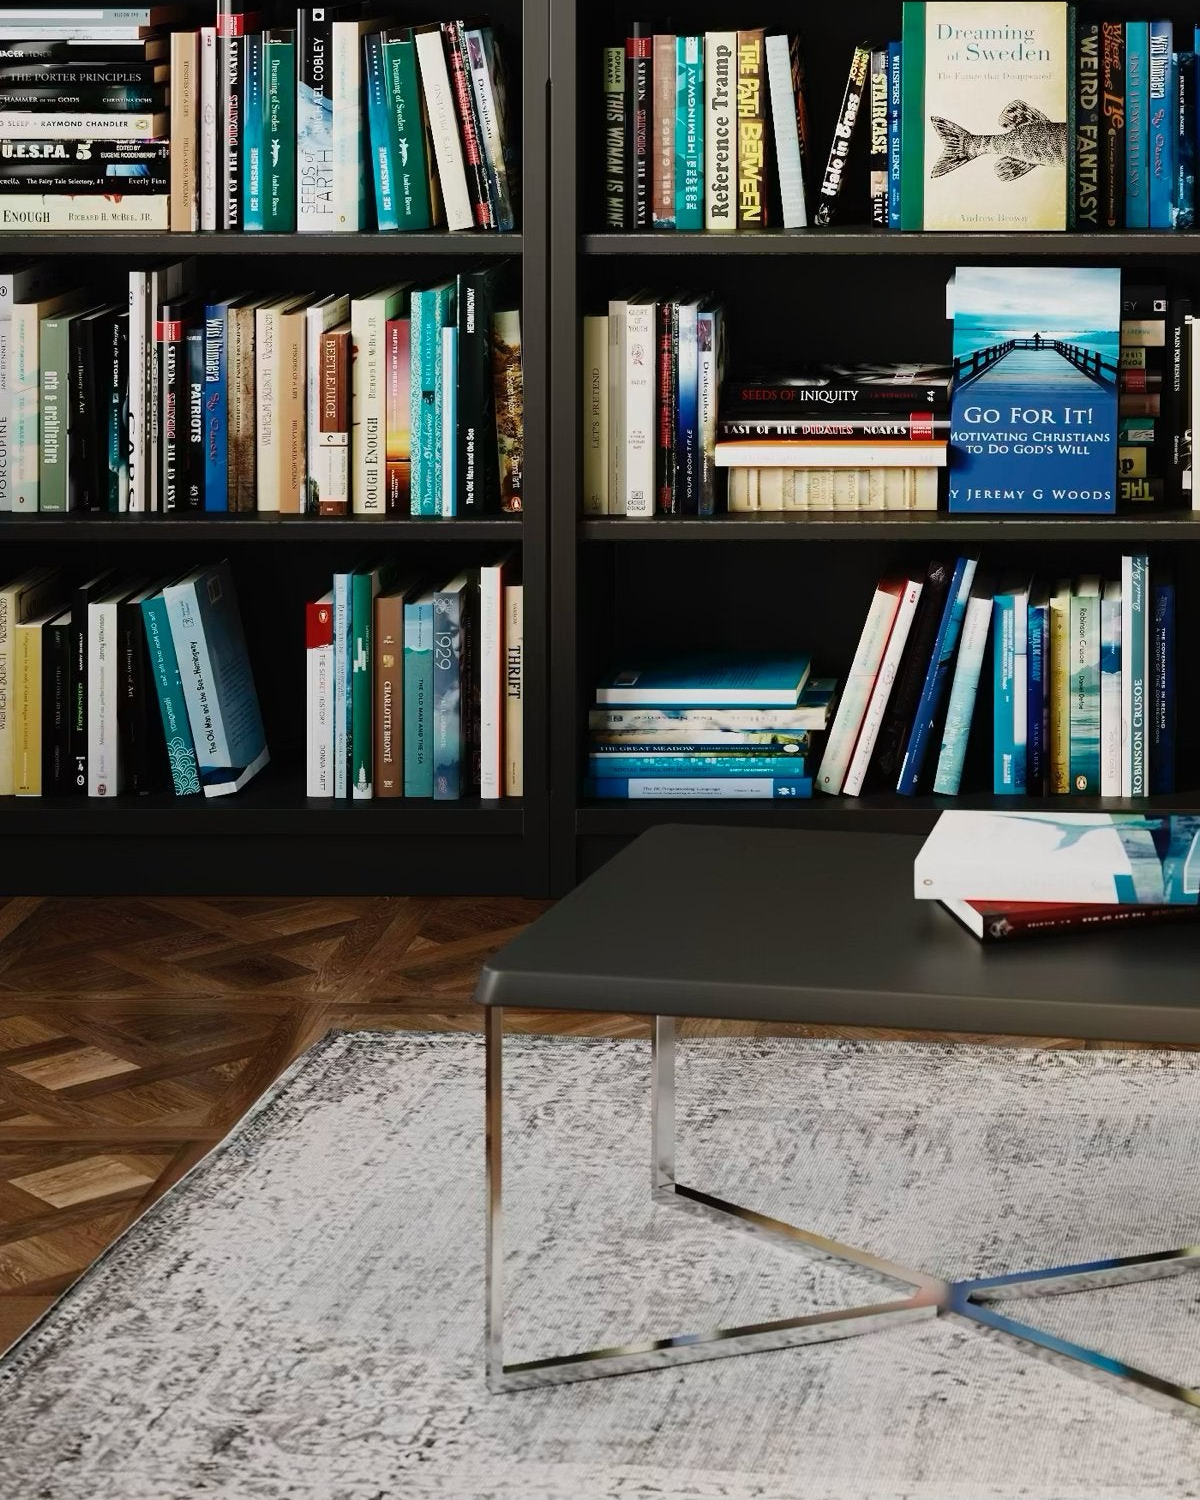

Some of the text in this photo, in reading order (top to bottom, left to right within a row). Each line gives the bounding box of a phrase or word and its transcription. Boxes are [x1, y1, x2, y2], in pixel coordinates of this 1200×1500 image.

[936, 24, 1035, 45] Dreaming
[947, 43, 1052, 61] of Sweden
[270, 59, 280, 94] Dreaming
[314, 37, 323, 81] COBLEY
[392, 59, 406, 132] Dreaming of Sweden
[607, 93, 623, 122] THIS
[688, 67, 696, 153] HEMINGWAY
[271, 104, 280, 132] Sweden
[711, 45, 730, 217] Reference Tramp
[737, 40, 763, 221] THE PATH BETWEEN
[1080, 36, 1098, 223] WEIRD FANTASY
[2, 142, 92, 160] U.E.S.P.A. 5
[607, 127, 623, 174] WOMAN
[301, 166, 316, 213] SEEDS
[607, 180, 623, 192] IS
[44, 371, 57, 390] arts
[326, 340, 336, 418] BEETLEJUICE
[592, 368, 600, 416] PRETEND
[44, 406, 60, 464] architecture
[190, 383, 201, 443] PATRIOTS
[964, 406, 1093, 425] GO FOR IT!
[966, 445, 1090, 455] TO DO GOD'S WILL
[1032, 432, 1110, 442] CHRISTIANS
[364, 417, 378, 509] ROUGH ENOUGH
[967, 489, 1111, 501] JEREMY G WOODS
[1120, 479, 1154, 501] THE
[1132, 582, 1141, 612] Daniel
[98, 643, 106, 661] Jonny
[435, 632, 451, 670] 1929
[1079, 608, 1087, 664] Robinson Crusoe
[508, 645, 520, 699] THRIFT
[384, 681, 392, 730] CHARLOTTE
[1133, 678, 1143, 794] ROBINSON CRUSOE
